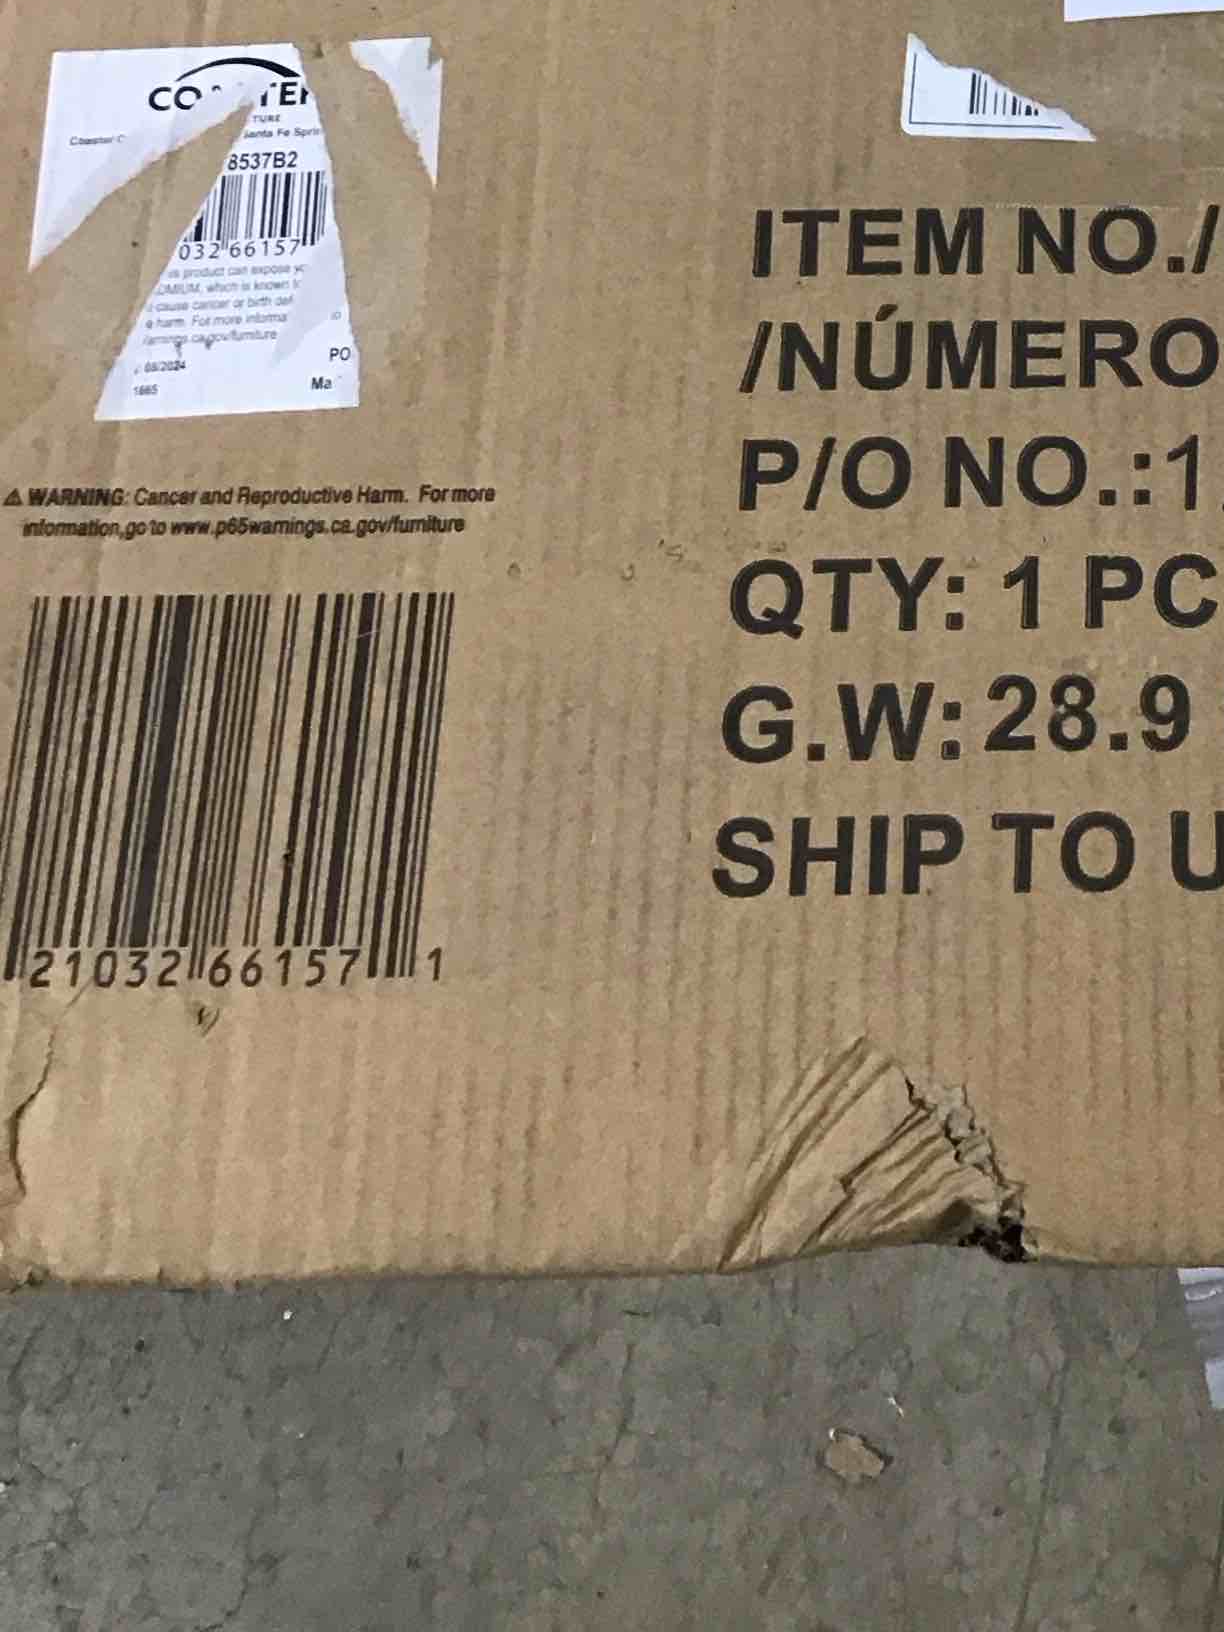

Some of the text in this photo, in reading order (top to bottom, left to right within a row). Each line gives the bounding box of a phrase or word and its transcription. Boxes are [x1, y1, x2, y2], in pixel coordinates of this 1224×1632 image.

[228, 152, 298, 170] 8537B2
[179, 239, 301, 260] 032 66157
[751, 206, 985, 278] ITEM
[329, 347, 351, 361] PO
[738, 304, 1221, 394] /NÚMERO
[28, 484, 496, 509] WARNING: Cancer and Reproductive Harm. For more
[738, 435, 912, 512] P/O
[150, 519, 167, 536] to
[729, 554, 1219, 640] QTY: 1 PC
[721, 681, 962, 764] G.W:
[984, 674, 1191, 754] 28.9
[712, 813, 965, 898] SHIP
[992, 810, 1136, 896] TO
[29, 946, 444, 988] 21032 66157 1
